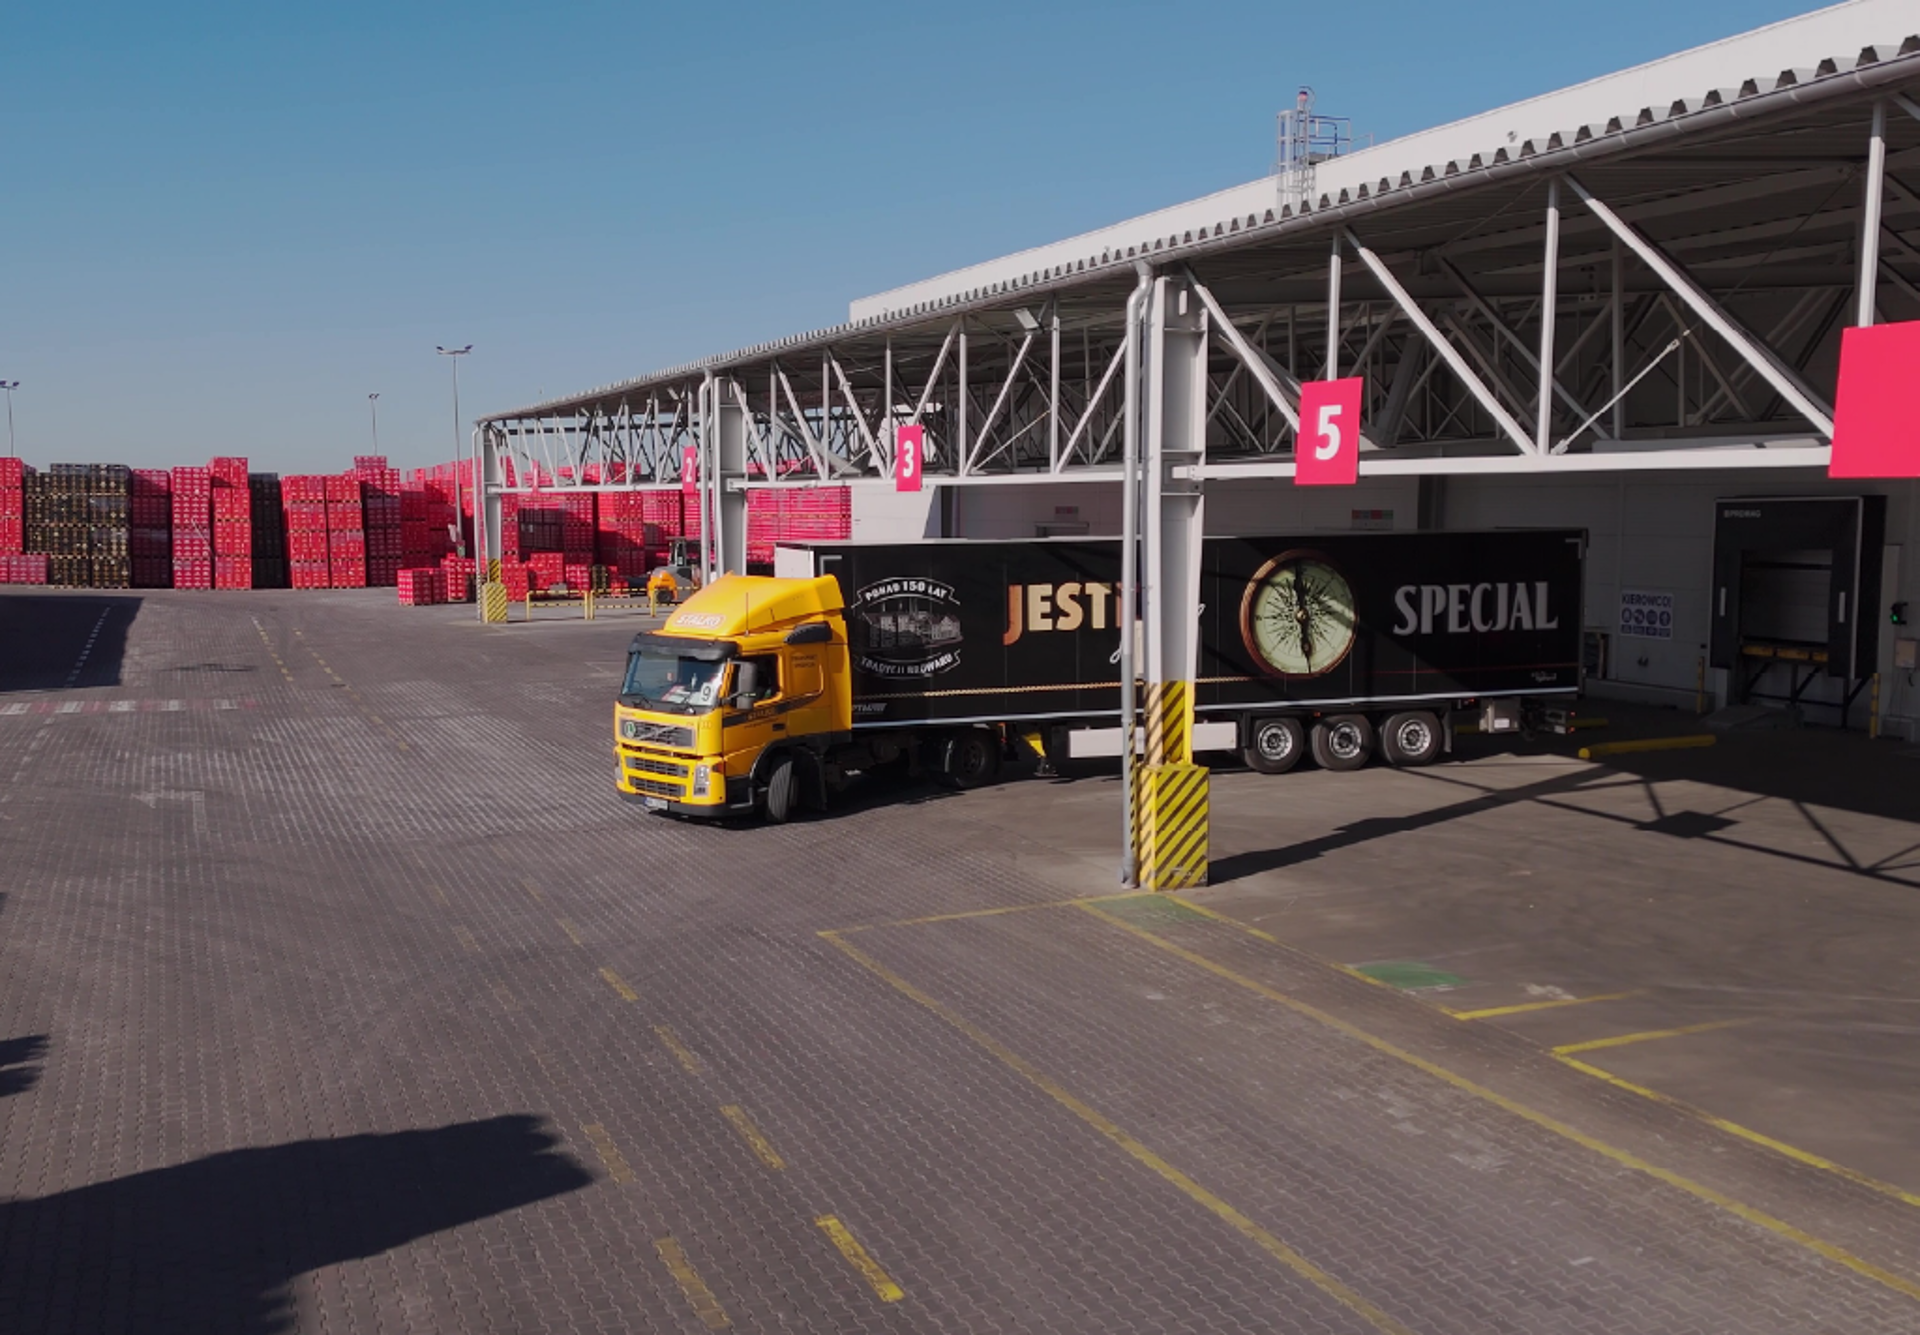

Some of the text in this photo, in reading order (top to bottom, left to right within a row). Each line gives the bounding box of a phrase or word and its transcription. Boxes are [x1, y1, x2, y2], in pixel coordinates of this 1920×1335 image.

[1315, 405, 1342, 460] 5
[686, 457, 693, 483] 2
[903, 440, 914, 478] 3
[865, 580, 948, 601] PONAD 150 LAT
[676, 614, 721, 627] STALKO
[1393, 581, 1558, 635] SPECJAL
[701, 685, 711, 702] 9
